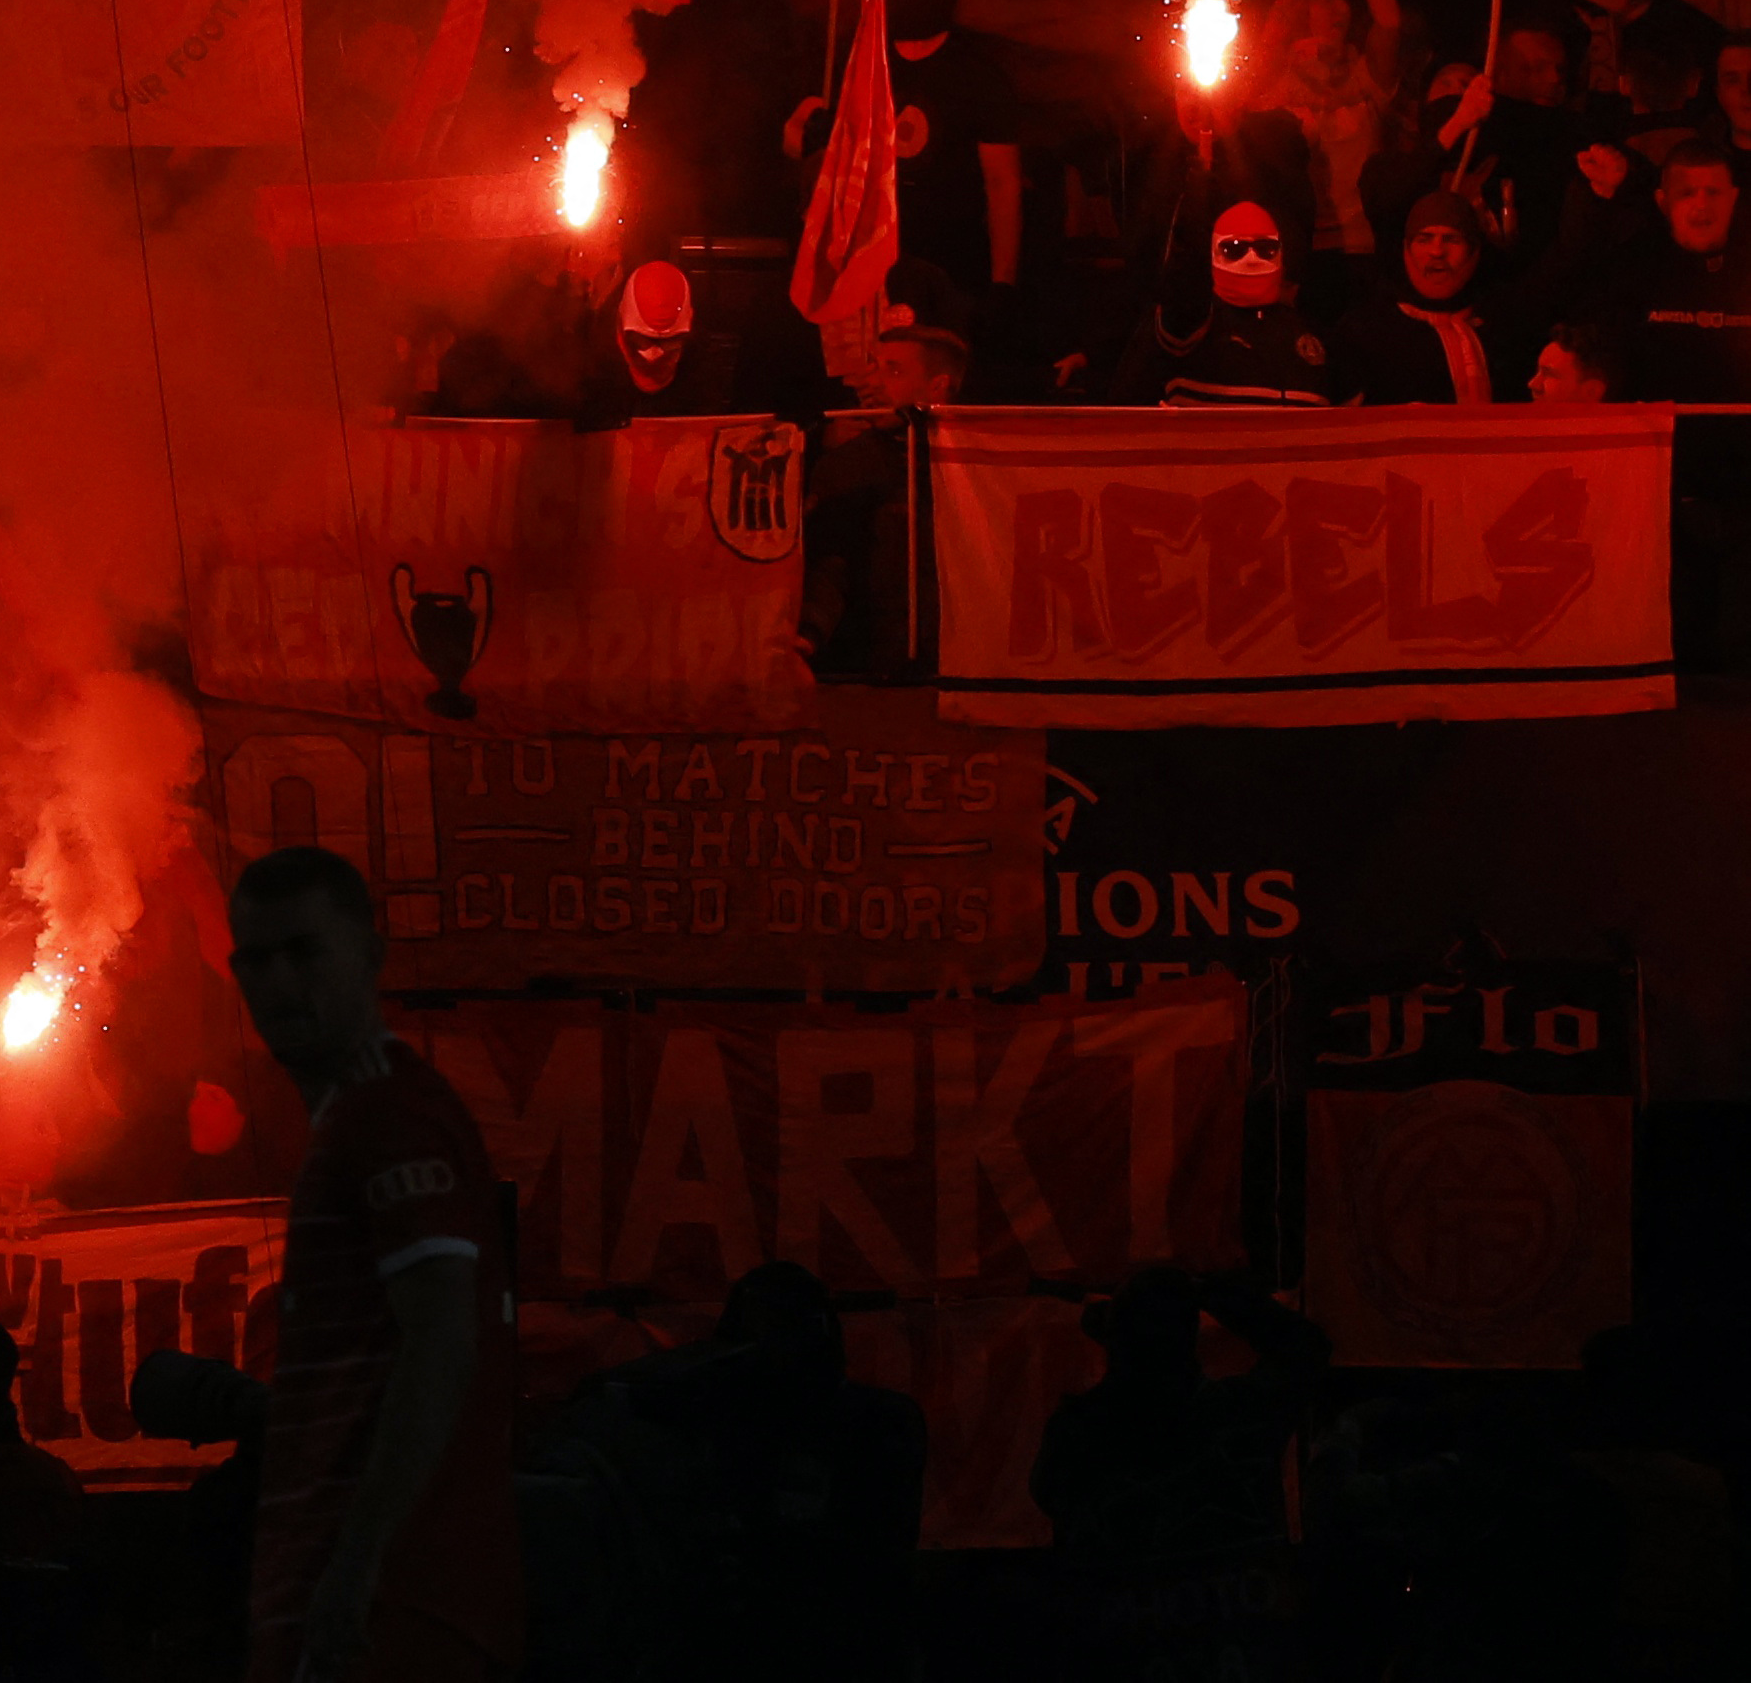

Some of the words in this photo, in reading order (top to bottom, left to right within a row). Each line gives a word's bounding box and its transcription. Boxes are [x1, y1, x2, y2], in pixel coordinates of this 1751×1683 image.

[1008, 466, 1596, 665] REBELS
[453, 738, 556, 796] TO
[603, 739, 1000, 814] MATCHES
[590, 807, 864, 875] BEHIND
[453, 873, 728, 937] CLOSED
[766, 877, 990, 945] DOORS
[1315, 980, 1601, 1064] Flo
[396, 1001, 1236, 1283] MARKT
